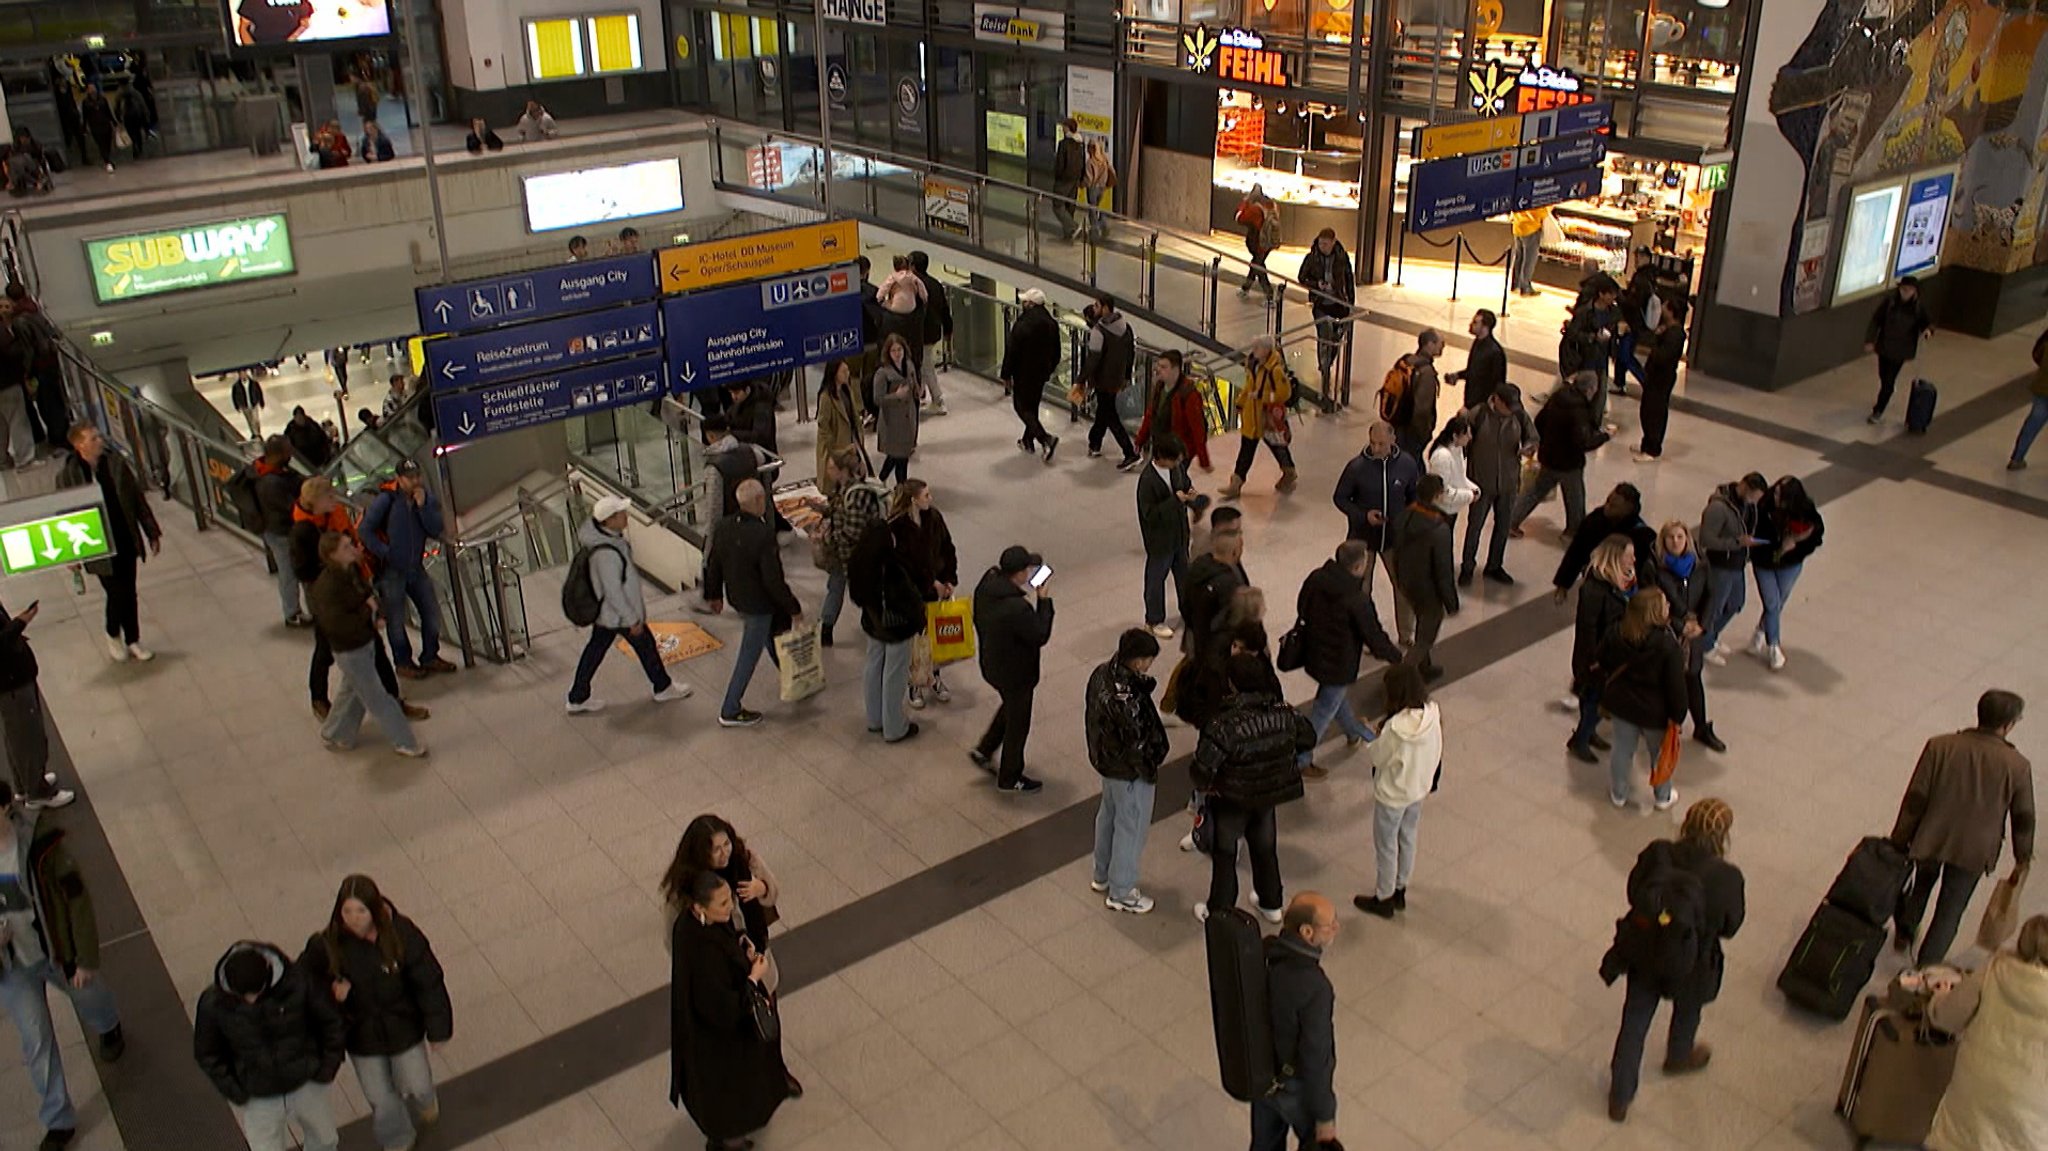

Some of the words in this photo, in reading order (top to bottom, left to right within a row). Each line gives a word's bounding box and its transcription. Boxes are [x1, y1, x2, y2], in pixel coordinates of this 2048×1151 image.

[823, 0, 884, 22] HANGE
[982, 17, 1007, 32] Reise
[1010, 23, 1034, 38] Bank
[103, 219, 278, 277] SUBWAY
[698, 248, 737, 264] IC-Hotel
[741, 246, 755, 258] DB
[756, 241, 794, 254] Museum
[700, 255, 775, 277] Oper/Schauspiel
[560, 274, 605, 290] Ausgang
[607, 270, 628, 283] City
[774, 285, 786, 303] U
[708, 332, 748, 348] Ausgang
[749, 328, 767, 340] City
[477, 341, 550, 363] ReiseZentrum
[708, 339, 784, 363] Bahnhofsmission
[482, 380, 560, 404] Schließfächer
[484, 397, 544, 418] Fundstelle
[938, 623, 961, 637] LEGO
